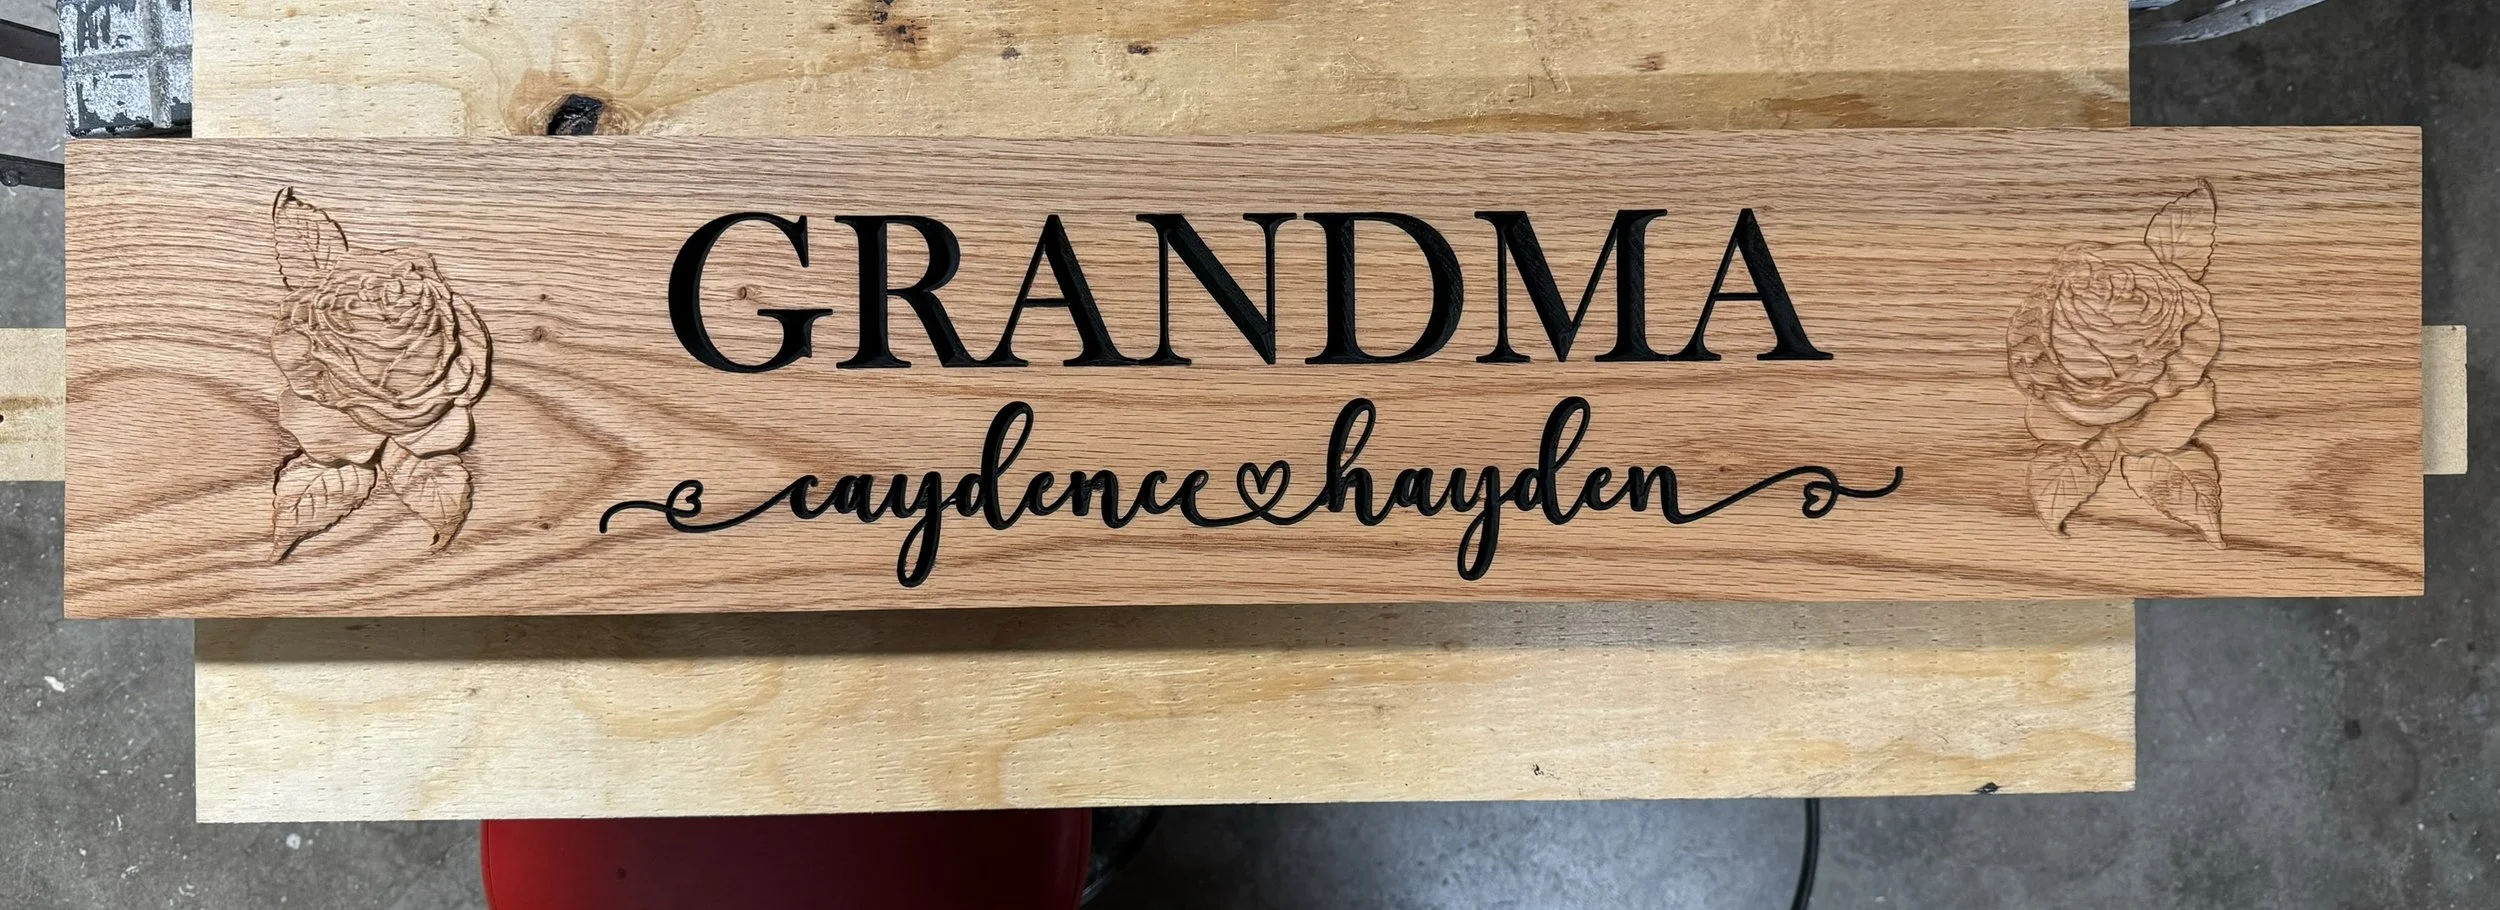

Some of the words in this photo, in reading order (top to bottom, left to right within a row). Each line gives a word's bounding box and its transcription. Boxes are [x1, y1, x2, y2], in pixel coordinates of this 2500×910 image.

[667, 208, 1834, 374] GRANDMA
[782, 400, 1214, 588] caydence
[1318, 396, 1692, 581] hayden
